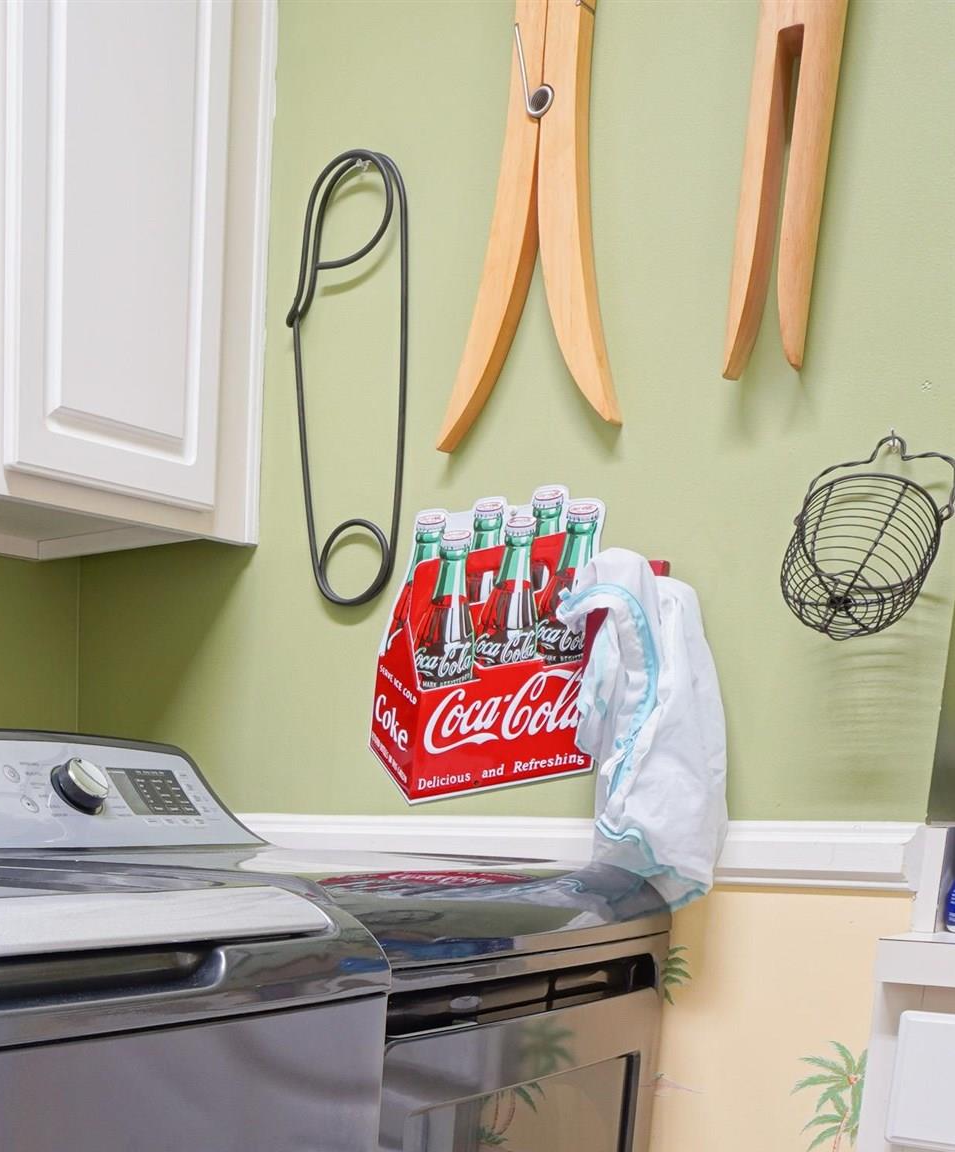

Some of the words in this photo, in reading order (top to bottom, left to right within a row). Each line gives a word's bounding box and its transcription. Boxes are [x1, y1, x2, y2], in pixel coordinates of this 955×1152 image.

[379, 665, 394, 684] SERVE
[393, 679, 403, 692] ICE
[402, 688, 418, 705] COLD
[375, 694, 409, 752] Coke
[418, 772, 471, 790] Delicious
[482, 764, 504, 778] and
[513, 754, 585, 773] Refreshing
